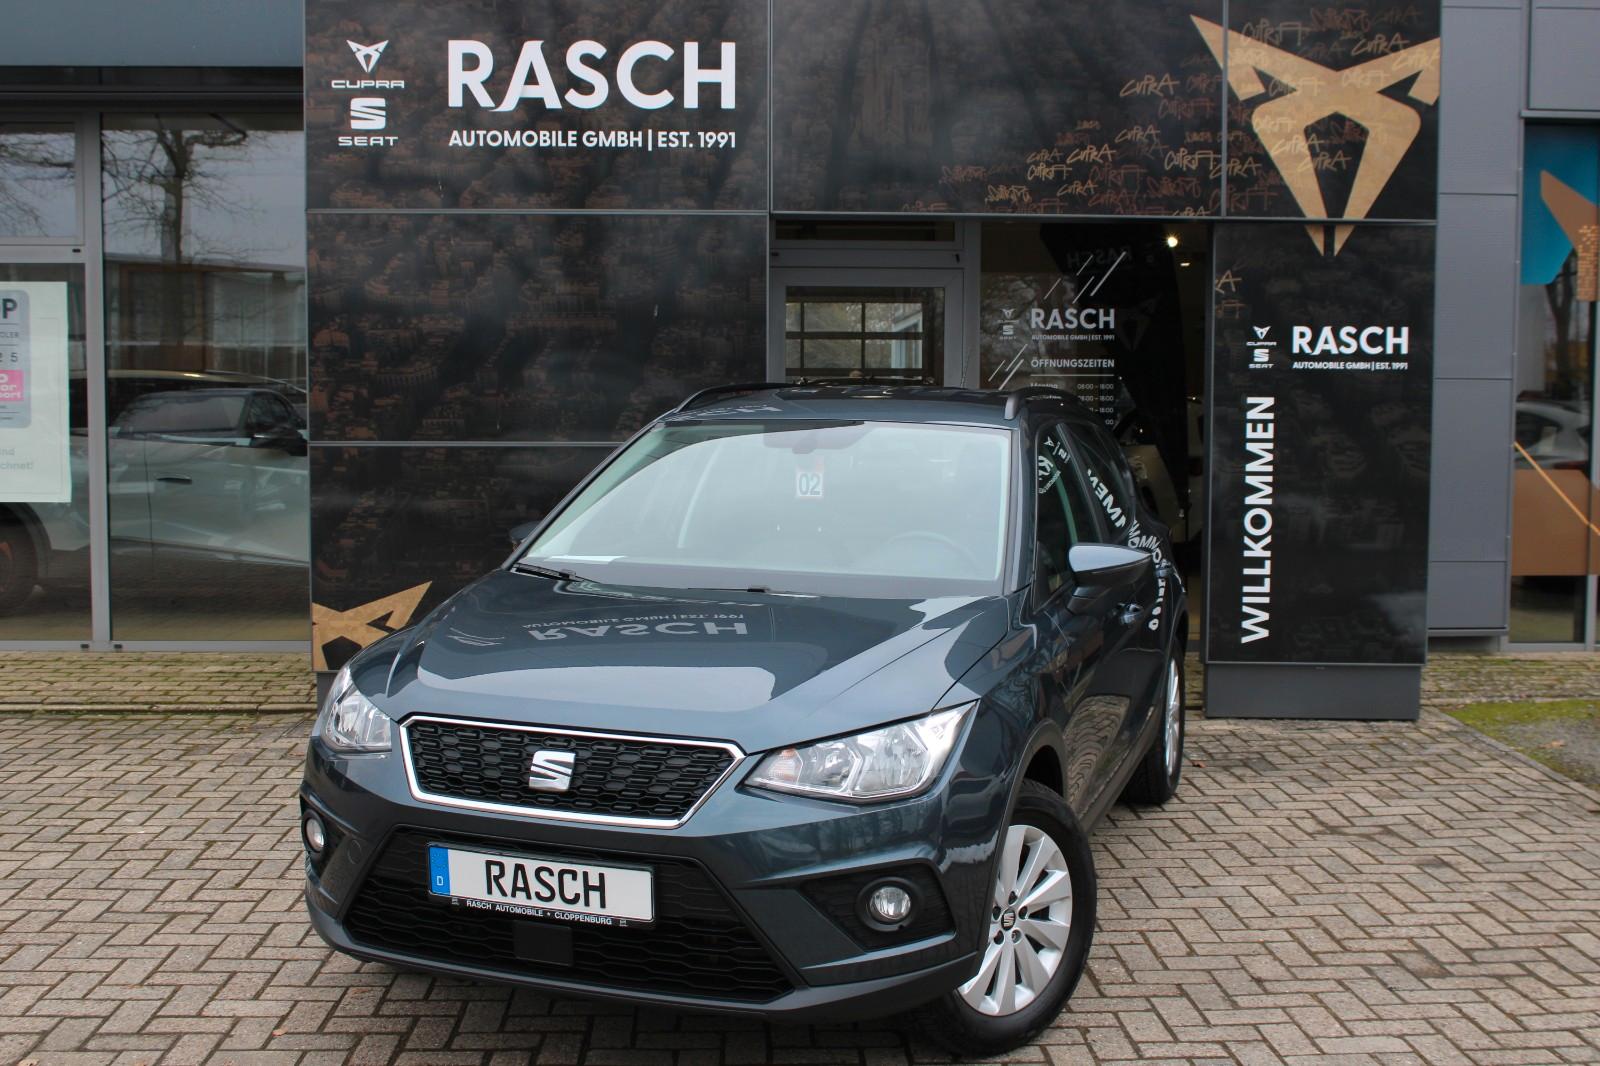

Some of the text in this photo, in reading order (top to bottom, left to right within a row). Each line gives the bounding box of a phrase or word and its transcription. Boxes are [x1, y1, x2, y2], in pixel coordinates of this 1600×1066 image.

[1352, 33, 1409, 56] CUPRA
[331, 80, 405, 89] CUPRA
[448, 39, 736, 112] RASCH
[1120, 73, 1180, 97] CUPRA
[338, 136, 398, 147] SEAT
[449, 131, 577, 147] AUTOMOBILE
[582, 131, 643, 148] GMBH
[657, 131, 694, 148] EST.
[697, 131, 736, 149] 1991
[1115, 124, 1161, 143] CUPRA
[1066, 144, 1117, 163] CUPRA
[1031, 308, 1115, 330] RASCH
[1292, 326, 1409, 355] RASCH
[1031, 357, 1115, 368] ÖFFNUNGSZEITEN
[1293, 361, 1345, 370] AUTOMOBILE
[1345, 361, 1370, 370] GMBH
[1375, 361, 1391, 370] EST.
[1391, 361, 1409, 370] 1991
[799, 473, 821, 496] 02
[1241, 396, 1275, 644] WILLKOMMEN
[436, 875, 444, 886] D
[485, 860, 606, 908] RASCH
[466, 900, 492, 910] RASCH
[495, 904, 544, 917] AUTOMOBILE
[554, 911, 613, 926] CLOPPENBURG
